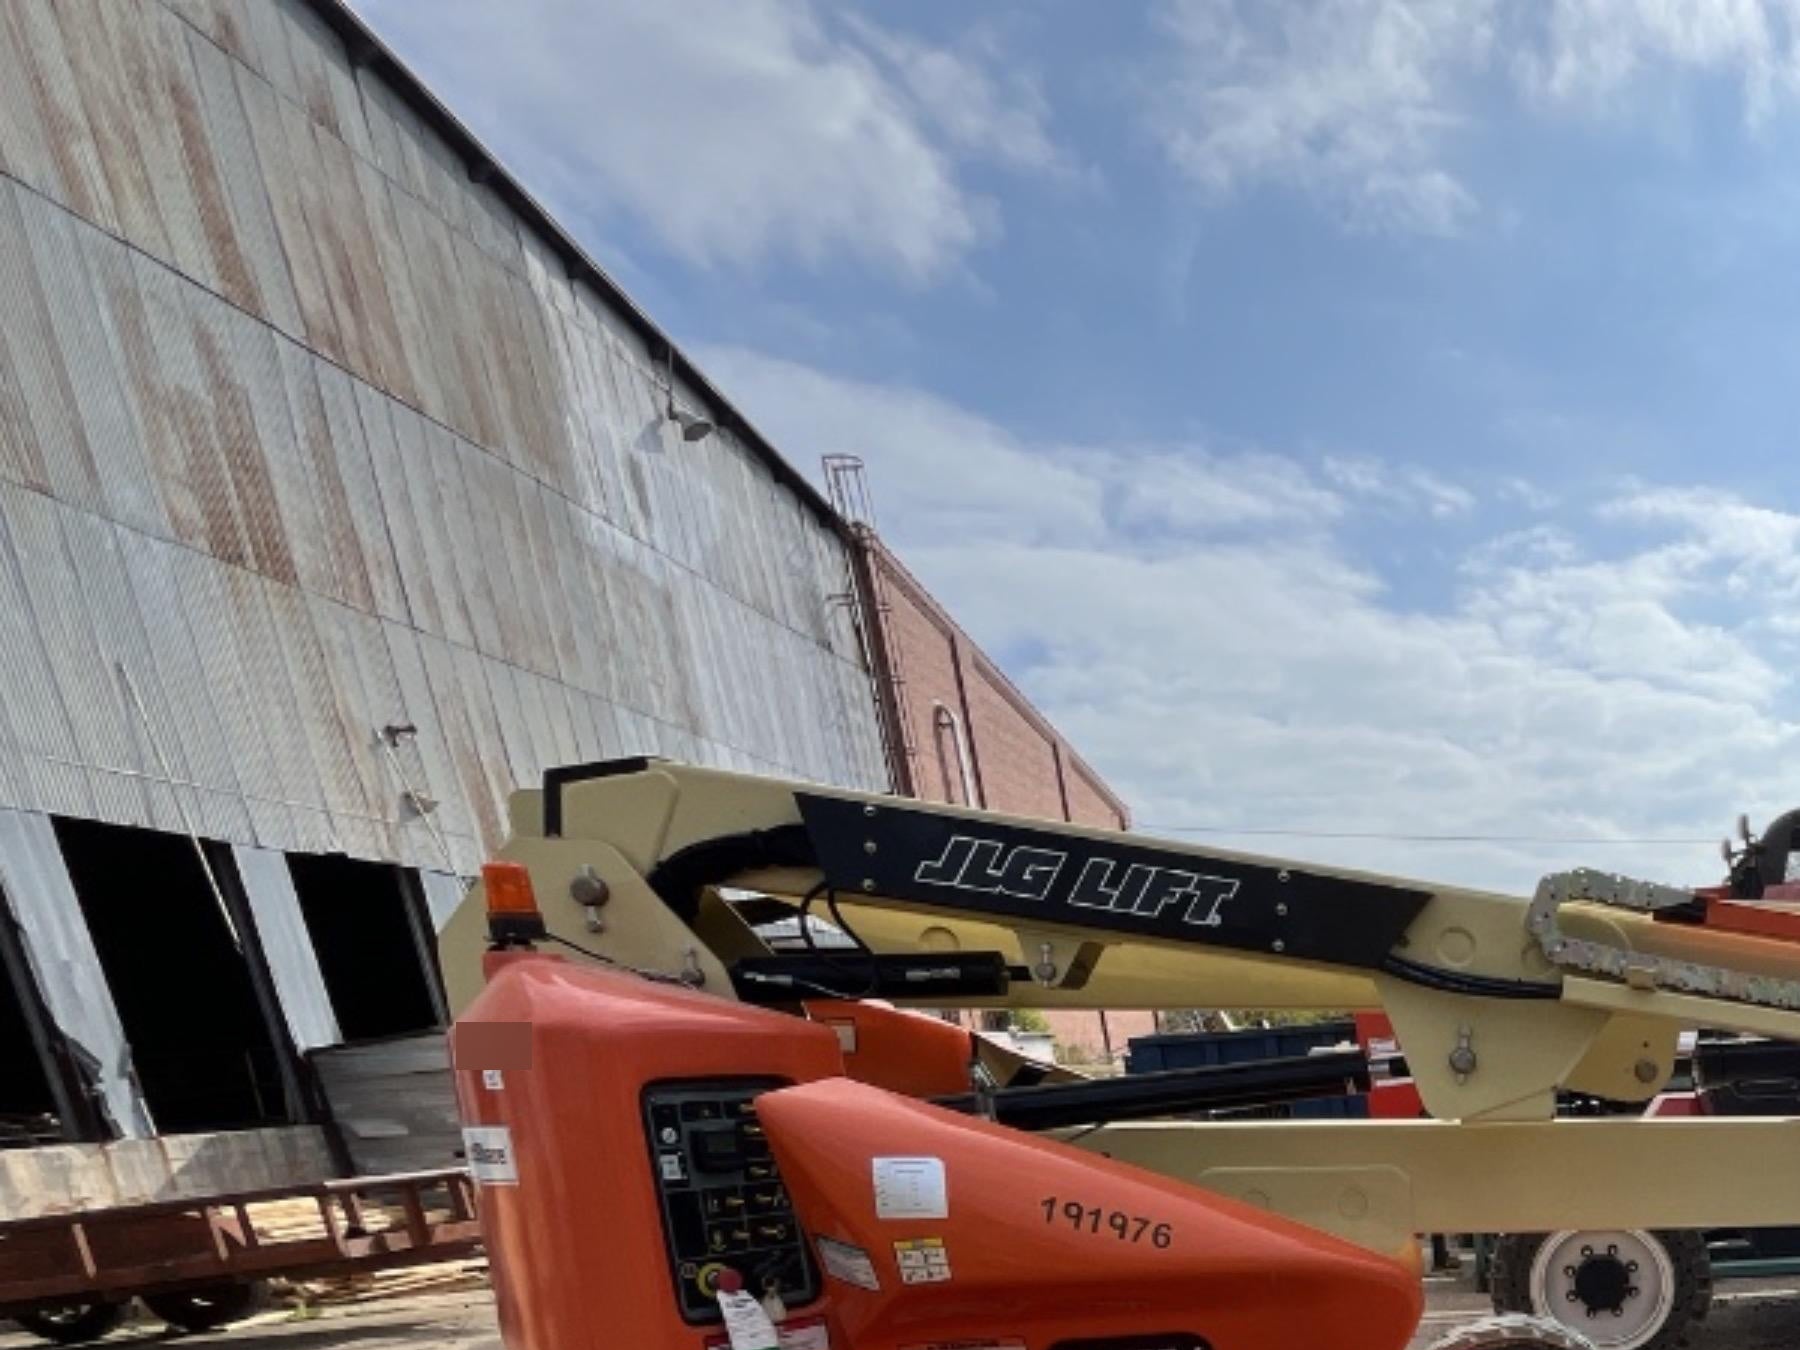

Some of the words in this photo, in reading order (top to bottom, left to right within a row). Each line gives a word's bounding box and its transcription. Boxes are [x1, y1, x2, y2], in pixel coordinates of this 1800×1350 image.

[913, 836, 1069, 901] JLG
[1067, 857, 1241, 927] LIFT
[1040, 1196, 1173, 1249] 191976
